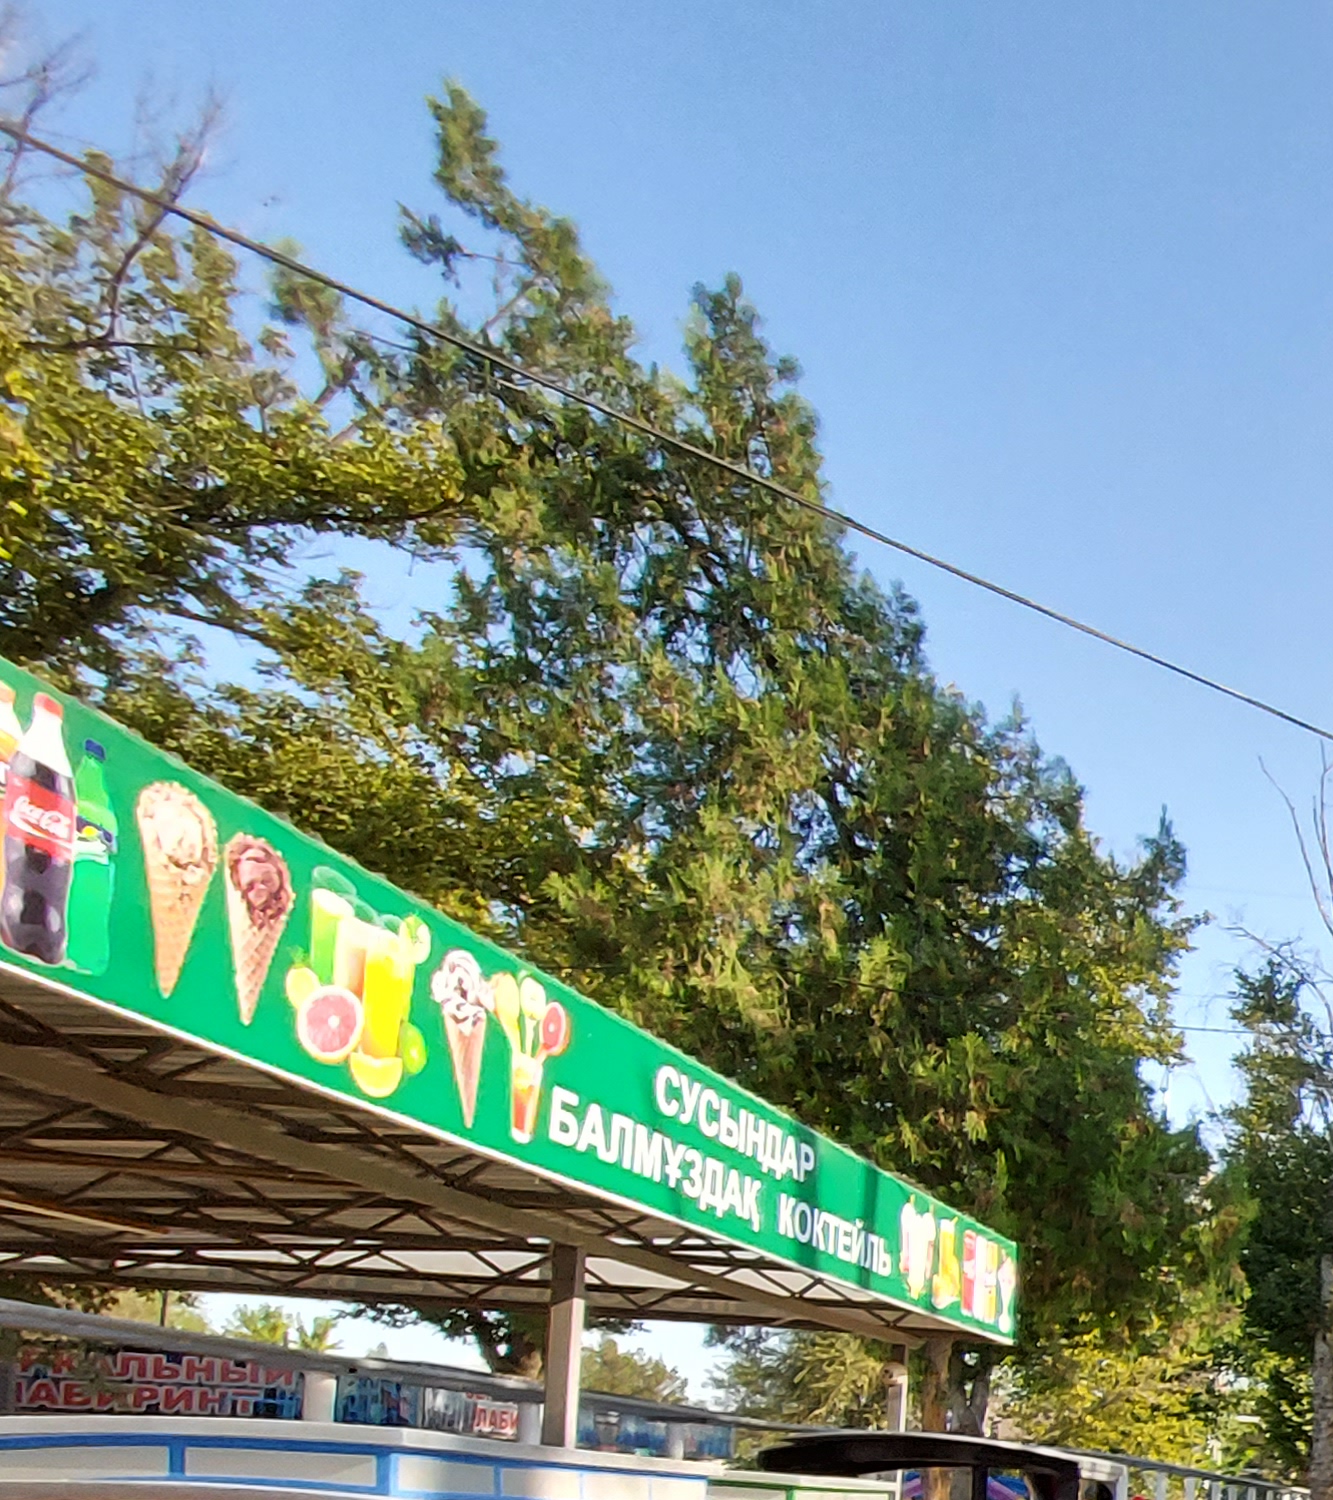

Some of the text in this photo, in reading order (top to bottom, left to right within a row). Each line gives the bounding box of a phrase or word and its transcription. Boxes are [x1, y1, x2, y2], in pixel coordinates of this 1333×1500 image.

[548, 1085, 893, 1277] БАЛМҰЗДАҚ КОКТЕЙЛЬ
[655, 1064, 815, 1182] СУСЫНДАР
